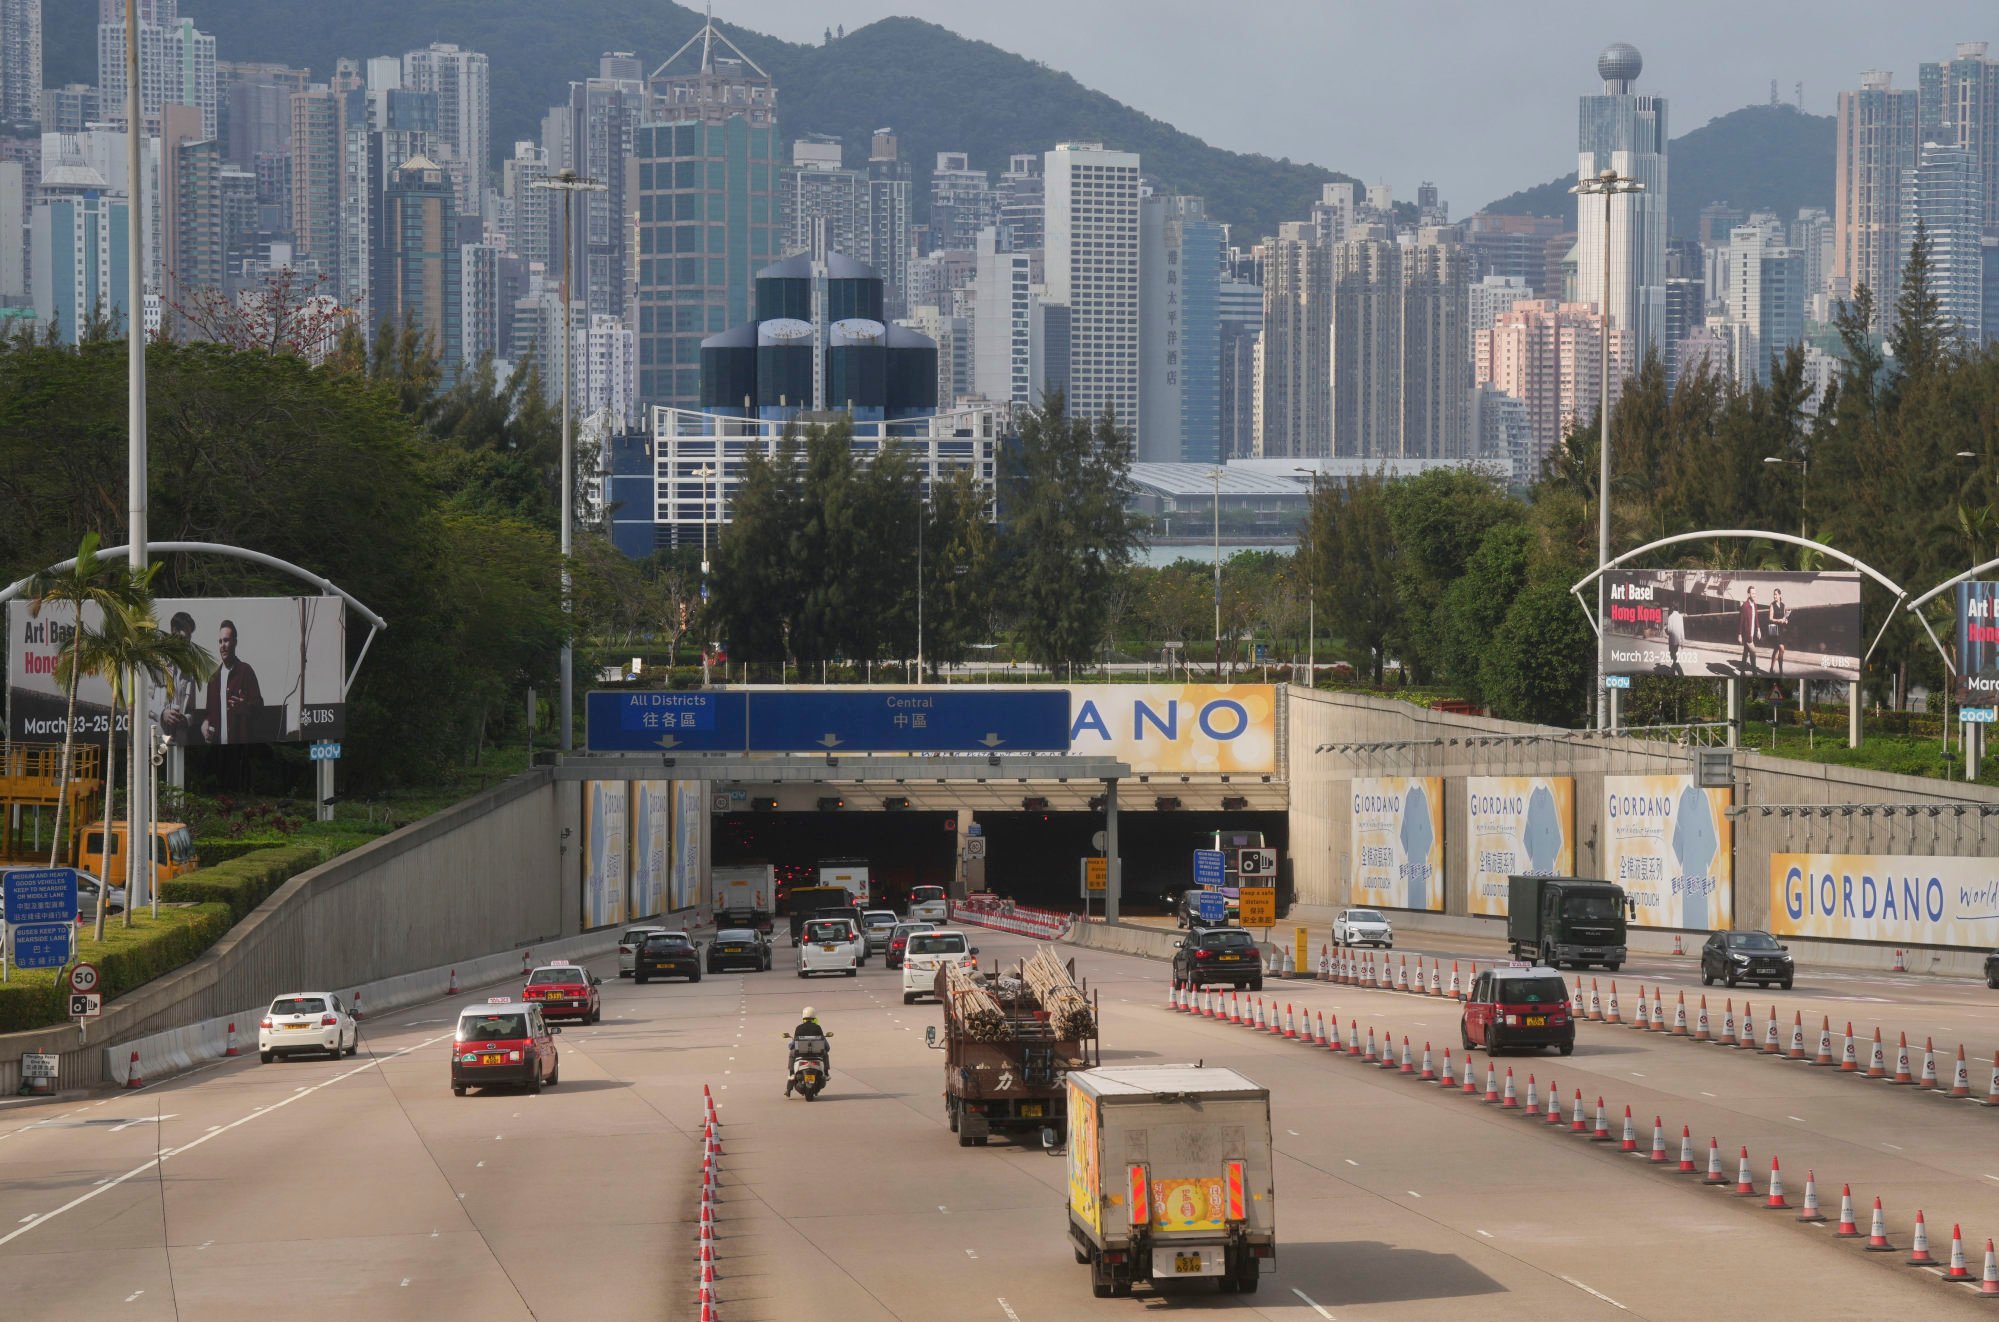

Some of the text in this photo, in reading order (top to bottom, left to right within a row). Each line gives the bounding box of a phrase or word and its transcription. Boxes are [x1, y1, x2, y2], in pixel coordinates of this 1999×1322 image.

[1611, 584, 1654, 601] Art Basel
[1611, 605, 1662, 624] Hong Kong
[1968, 599, 1988, 617] Art
[25, 621, 44, 643] Art
[1611, 650, 1641, 662] March
[1676, 652, 1698, 664] 2023
[630, 695, 706, 706] All Districts
[887, 696, 933, 708] Central
[313, 709, 334, 723] UBS
[643, 712, 696, 728] 往各區
[894, 713, 927, 728] 中區
[1960, 710, 1994, 722] cody
[25, 717, 66, 734] March
[311, 744, 340, 758] cody
[1354, 793, 1400, 814] GIORDANO
[1471, 794, 1523, 816] GIORDANO
[1609, 793, 1671, 818] GIORDANO
[1785, 867, 1944, 922] GIORDANO
[75, 972, 94, 984] 50
[994, 1071, 1013, 1091] 力
